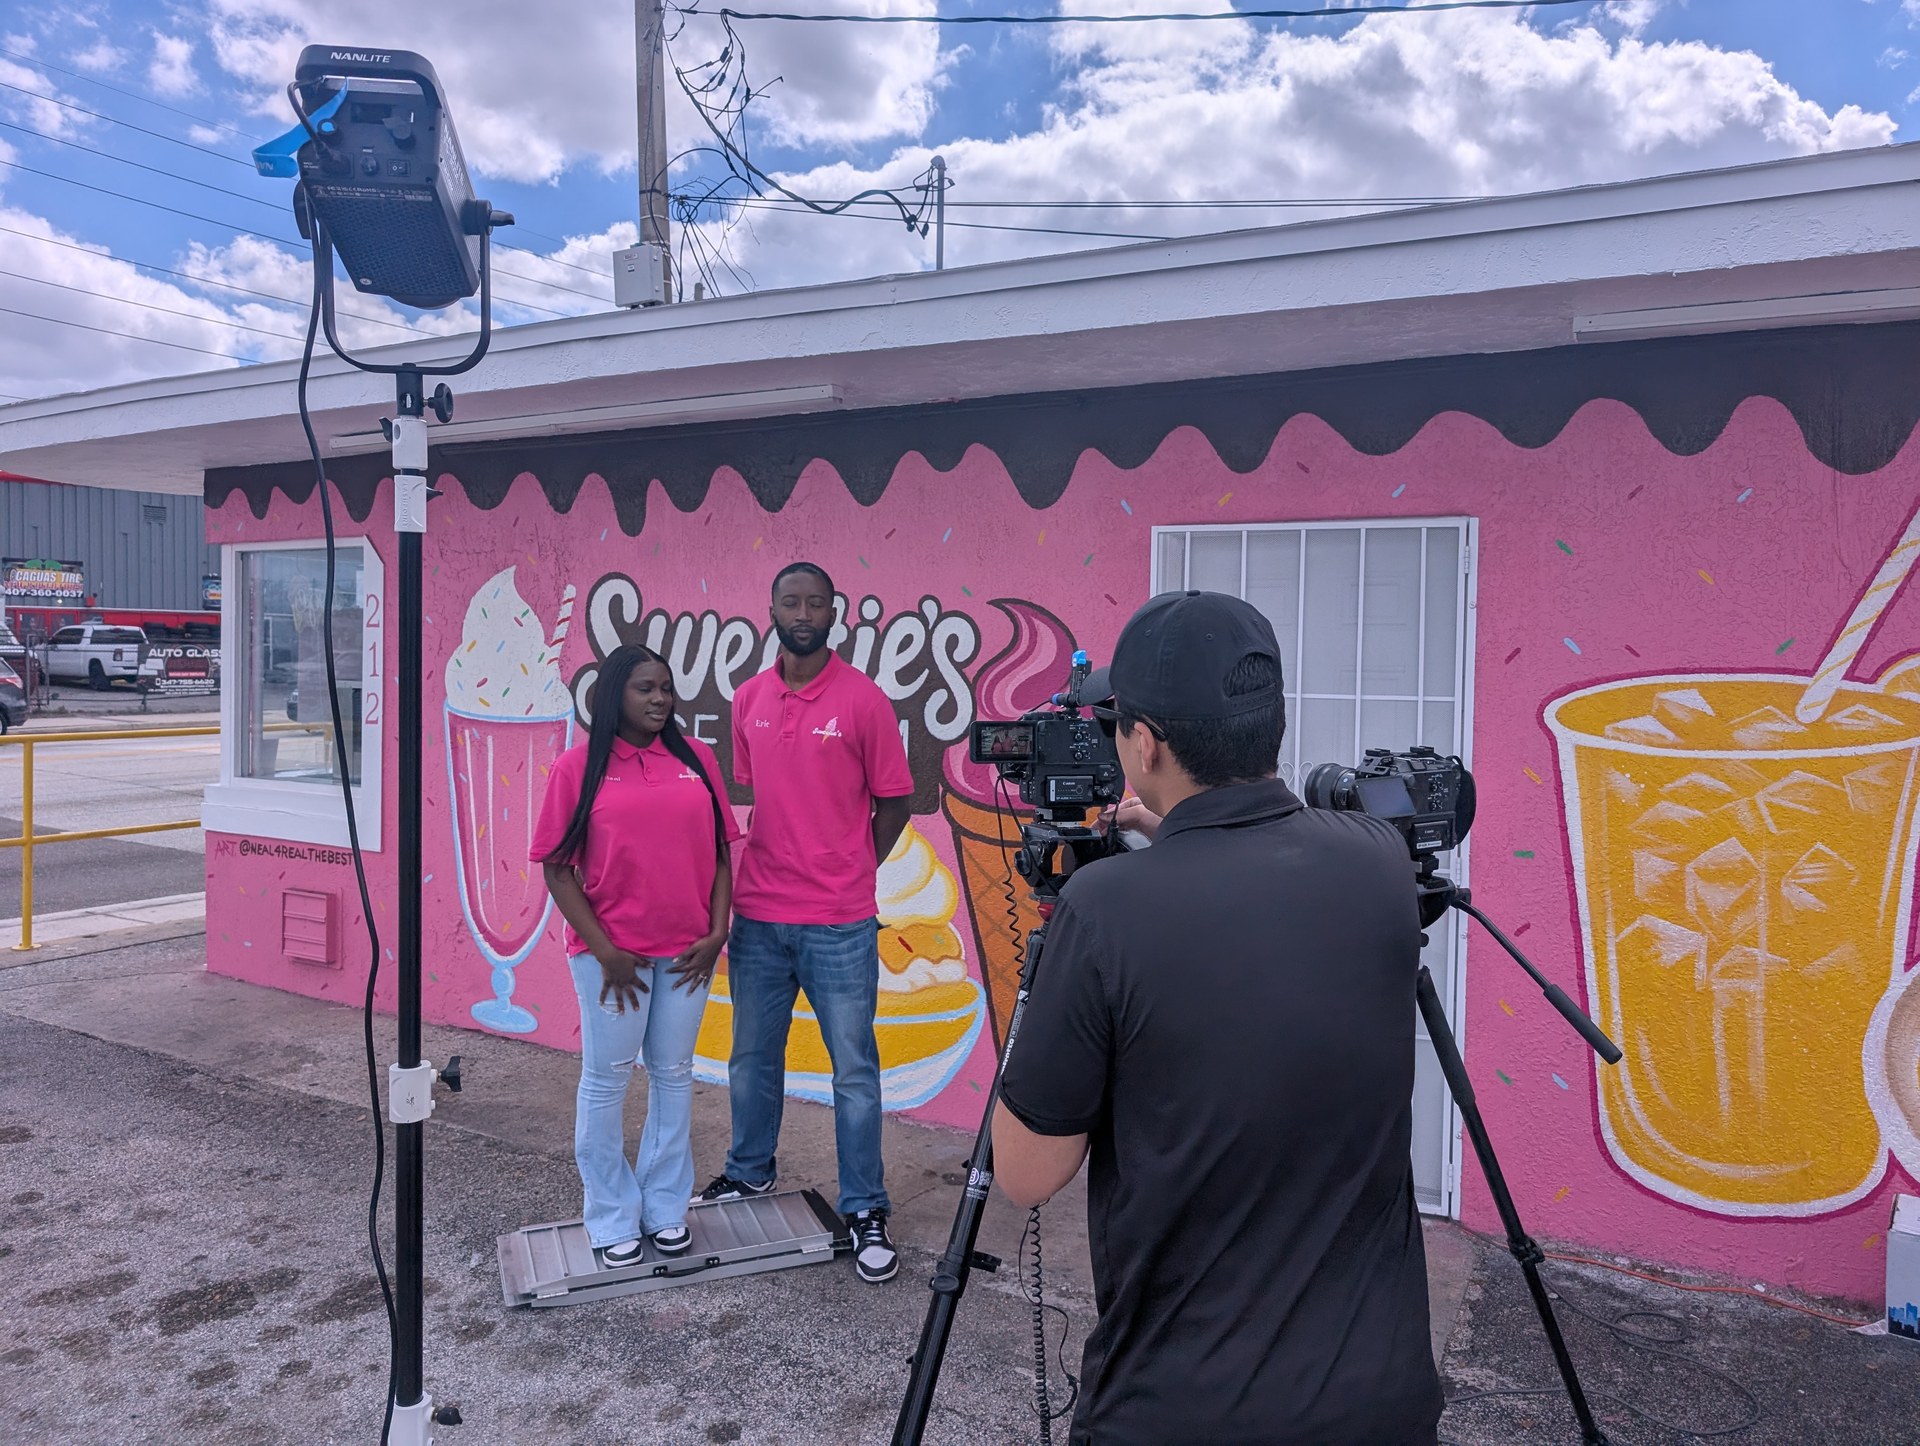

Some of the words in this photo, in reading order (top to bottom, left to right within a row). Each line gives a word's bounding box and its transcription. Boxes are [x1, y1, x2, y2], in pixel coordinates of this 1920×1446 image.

[330, 51, 391, 63] NANLITE
[15, 571, 57, 583] CAGUAS
[61, 572, 81, 583] TIRE
[5, 588, 84, 598] 407-360-0037
[148, 648, 183, 657] AUTO
[575, 578, 976, 742] Sweie's
[755, 719, 770, 728] Eric
[239, 839, 354, 866] @NEAL4REALTHEBEST
